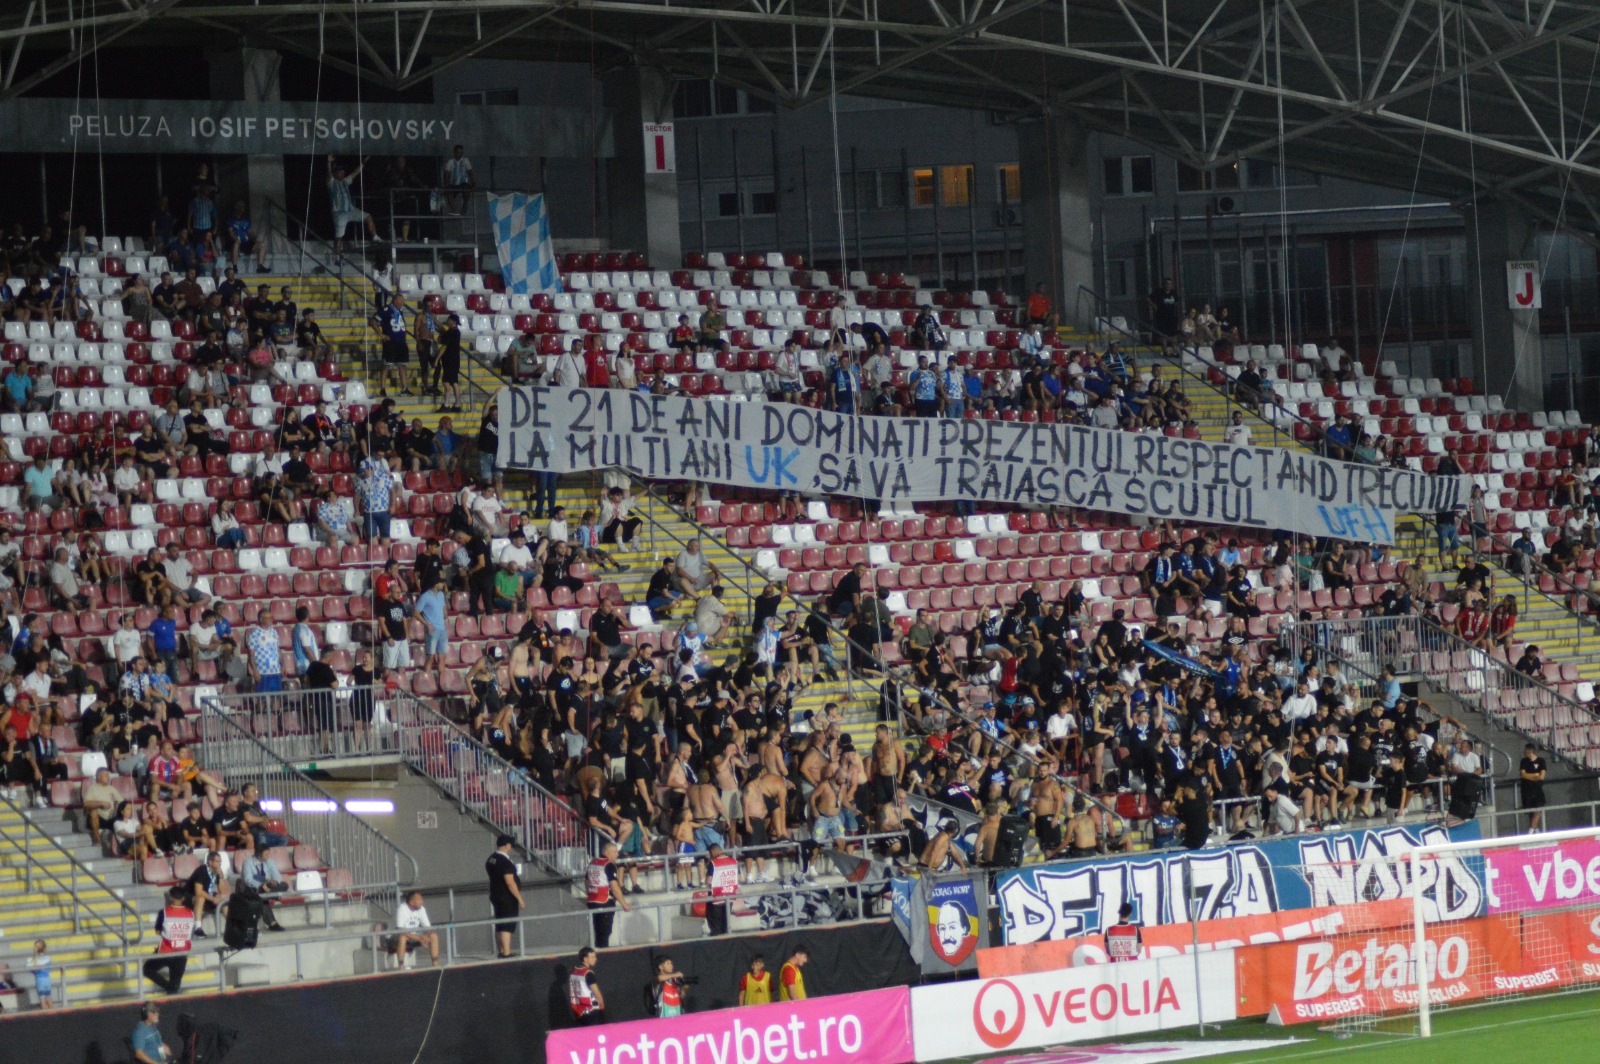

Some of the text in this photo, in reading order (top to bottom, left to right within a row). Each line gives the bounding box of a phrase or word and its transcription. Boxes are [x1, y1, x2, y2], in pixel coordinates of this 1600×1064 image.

[69, 115, 454, 140] PELUZA IOSIF PETSCHOVSKY
[1511, 262, 1535, 270] SECTOR
[1516, 272, 1534, 305] J
[508, 387, 551, 429] DE
[568, 390, 613, 433] 21
[629, 392, 667, 434] DE
[676, 399, 741, 440] ANI
[506, 430, 549, 469] LA
[680, 438, 732, 481] ANI
[745, 445, 799, 485] UK
[1317, 503, 1391, 541] UFH
[1493, 967, 1560, 990] SUPERBET
[1033, 977, 1181, 1028] VEOLIA
[1295, 994, 1367, 1018] SUPERBET
